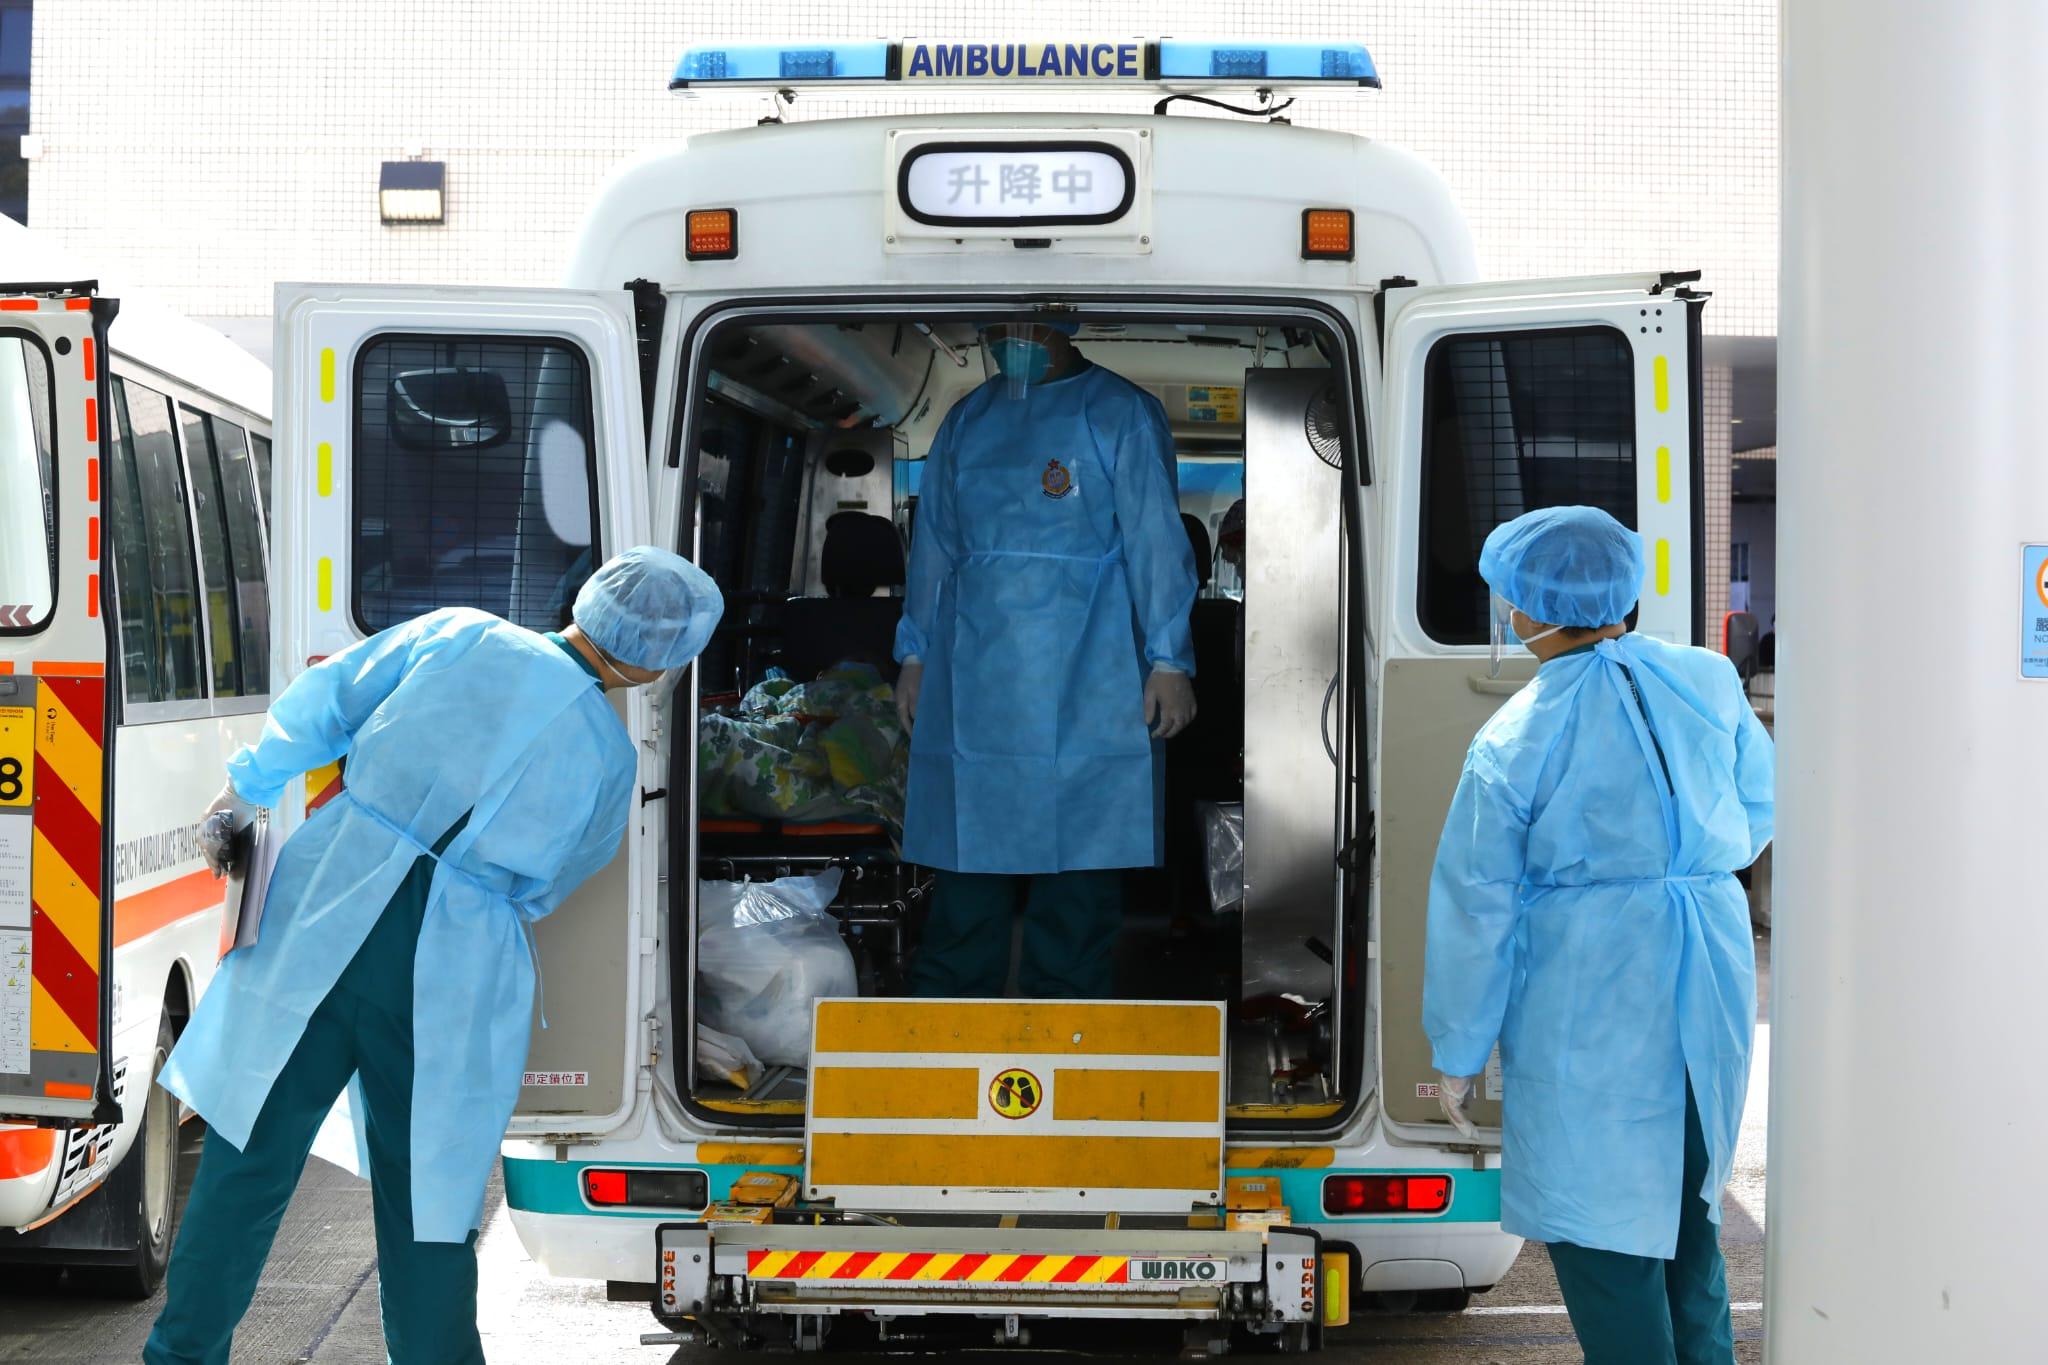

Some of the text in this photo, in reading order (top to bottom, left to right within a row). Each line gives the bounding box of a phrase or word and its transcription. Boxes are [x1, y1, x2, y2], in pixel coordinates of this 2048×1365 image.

[908, 43, 1138, 77] AMBULANCE
[947, 164, 1094, 205] 升降中
[139, 828, 176, 877] AMBULANCE
[663, 1250, 676, 1306] WAKO
[1141, 1261, 1216, 1280] WAKO
[1301, 1258, 1314, 1313] WAKO
